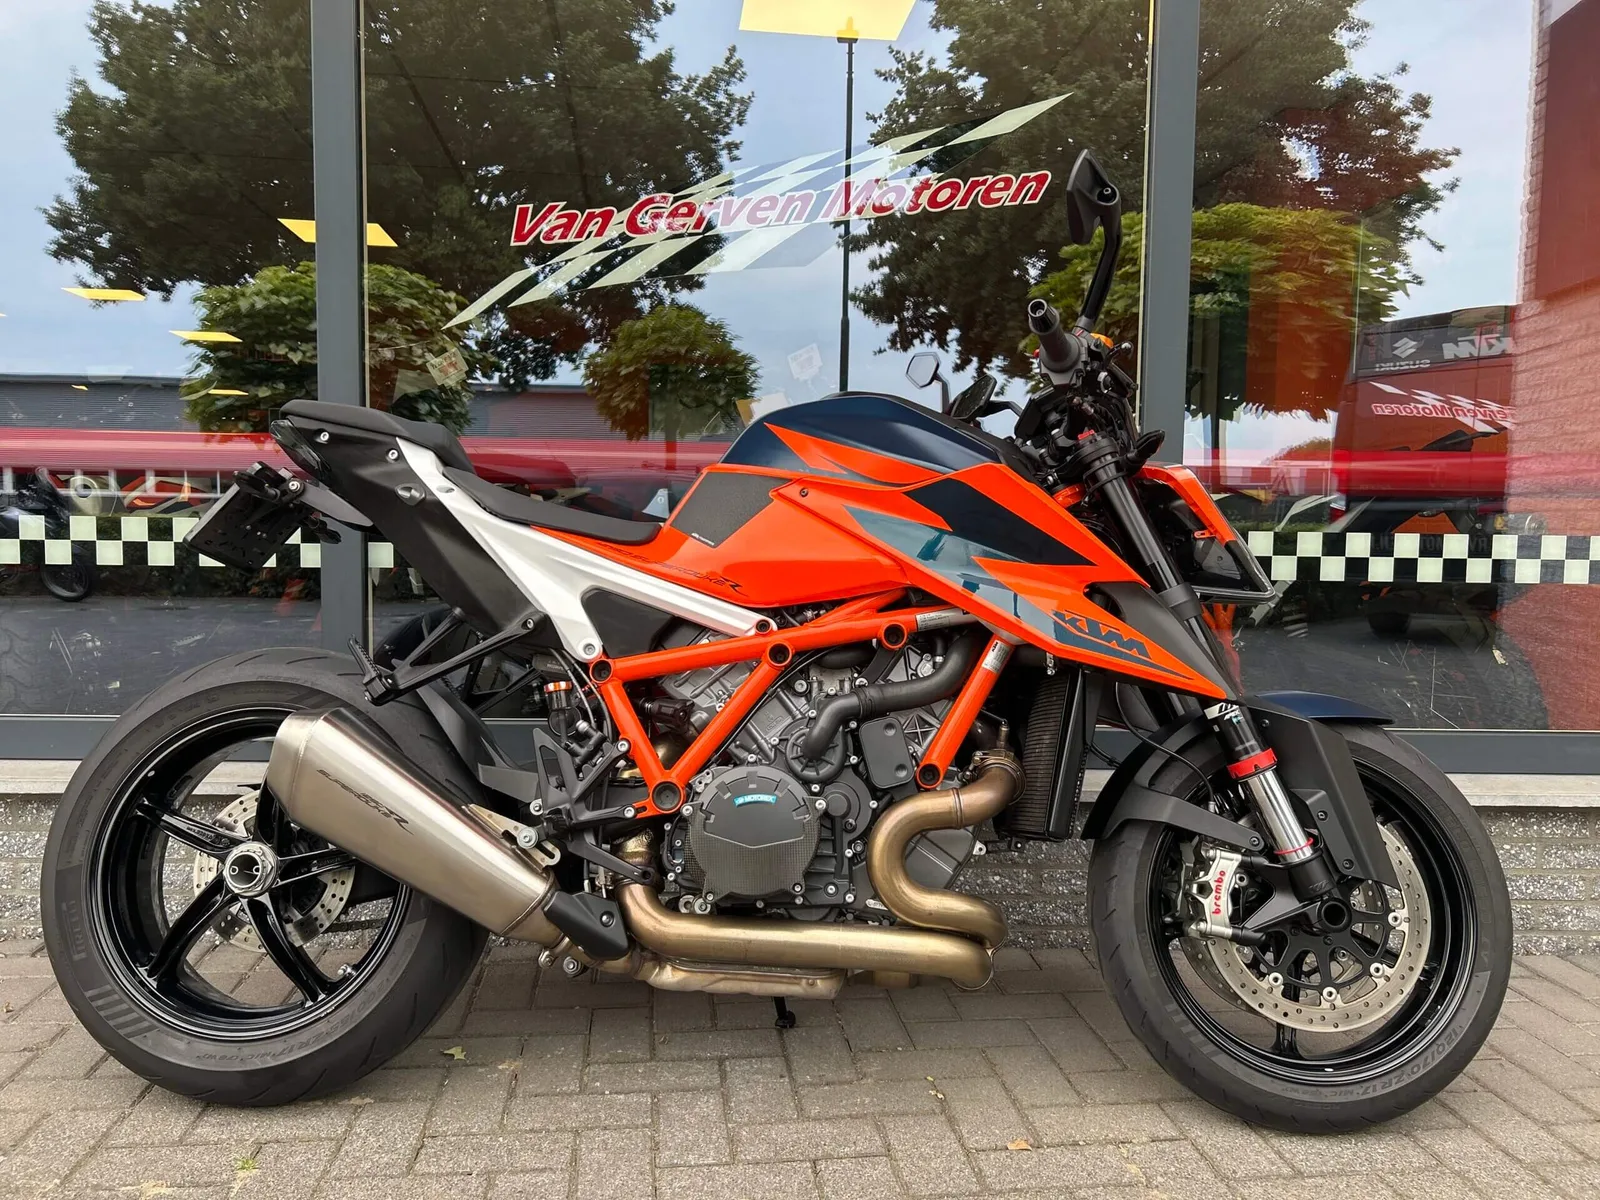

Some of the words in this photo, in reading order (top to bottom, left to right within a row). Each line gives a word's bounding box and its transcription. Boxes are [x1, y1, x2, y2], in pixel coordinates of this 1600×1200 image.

[510, 202, 617, 247] Van
[625, 192, 811, 237] Gerven
[820, 169, 1052, 220] Motoren
[1053, 609, 1152, 660] KTM
[1212, 870, 1226, 915] brembo
